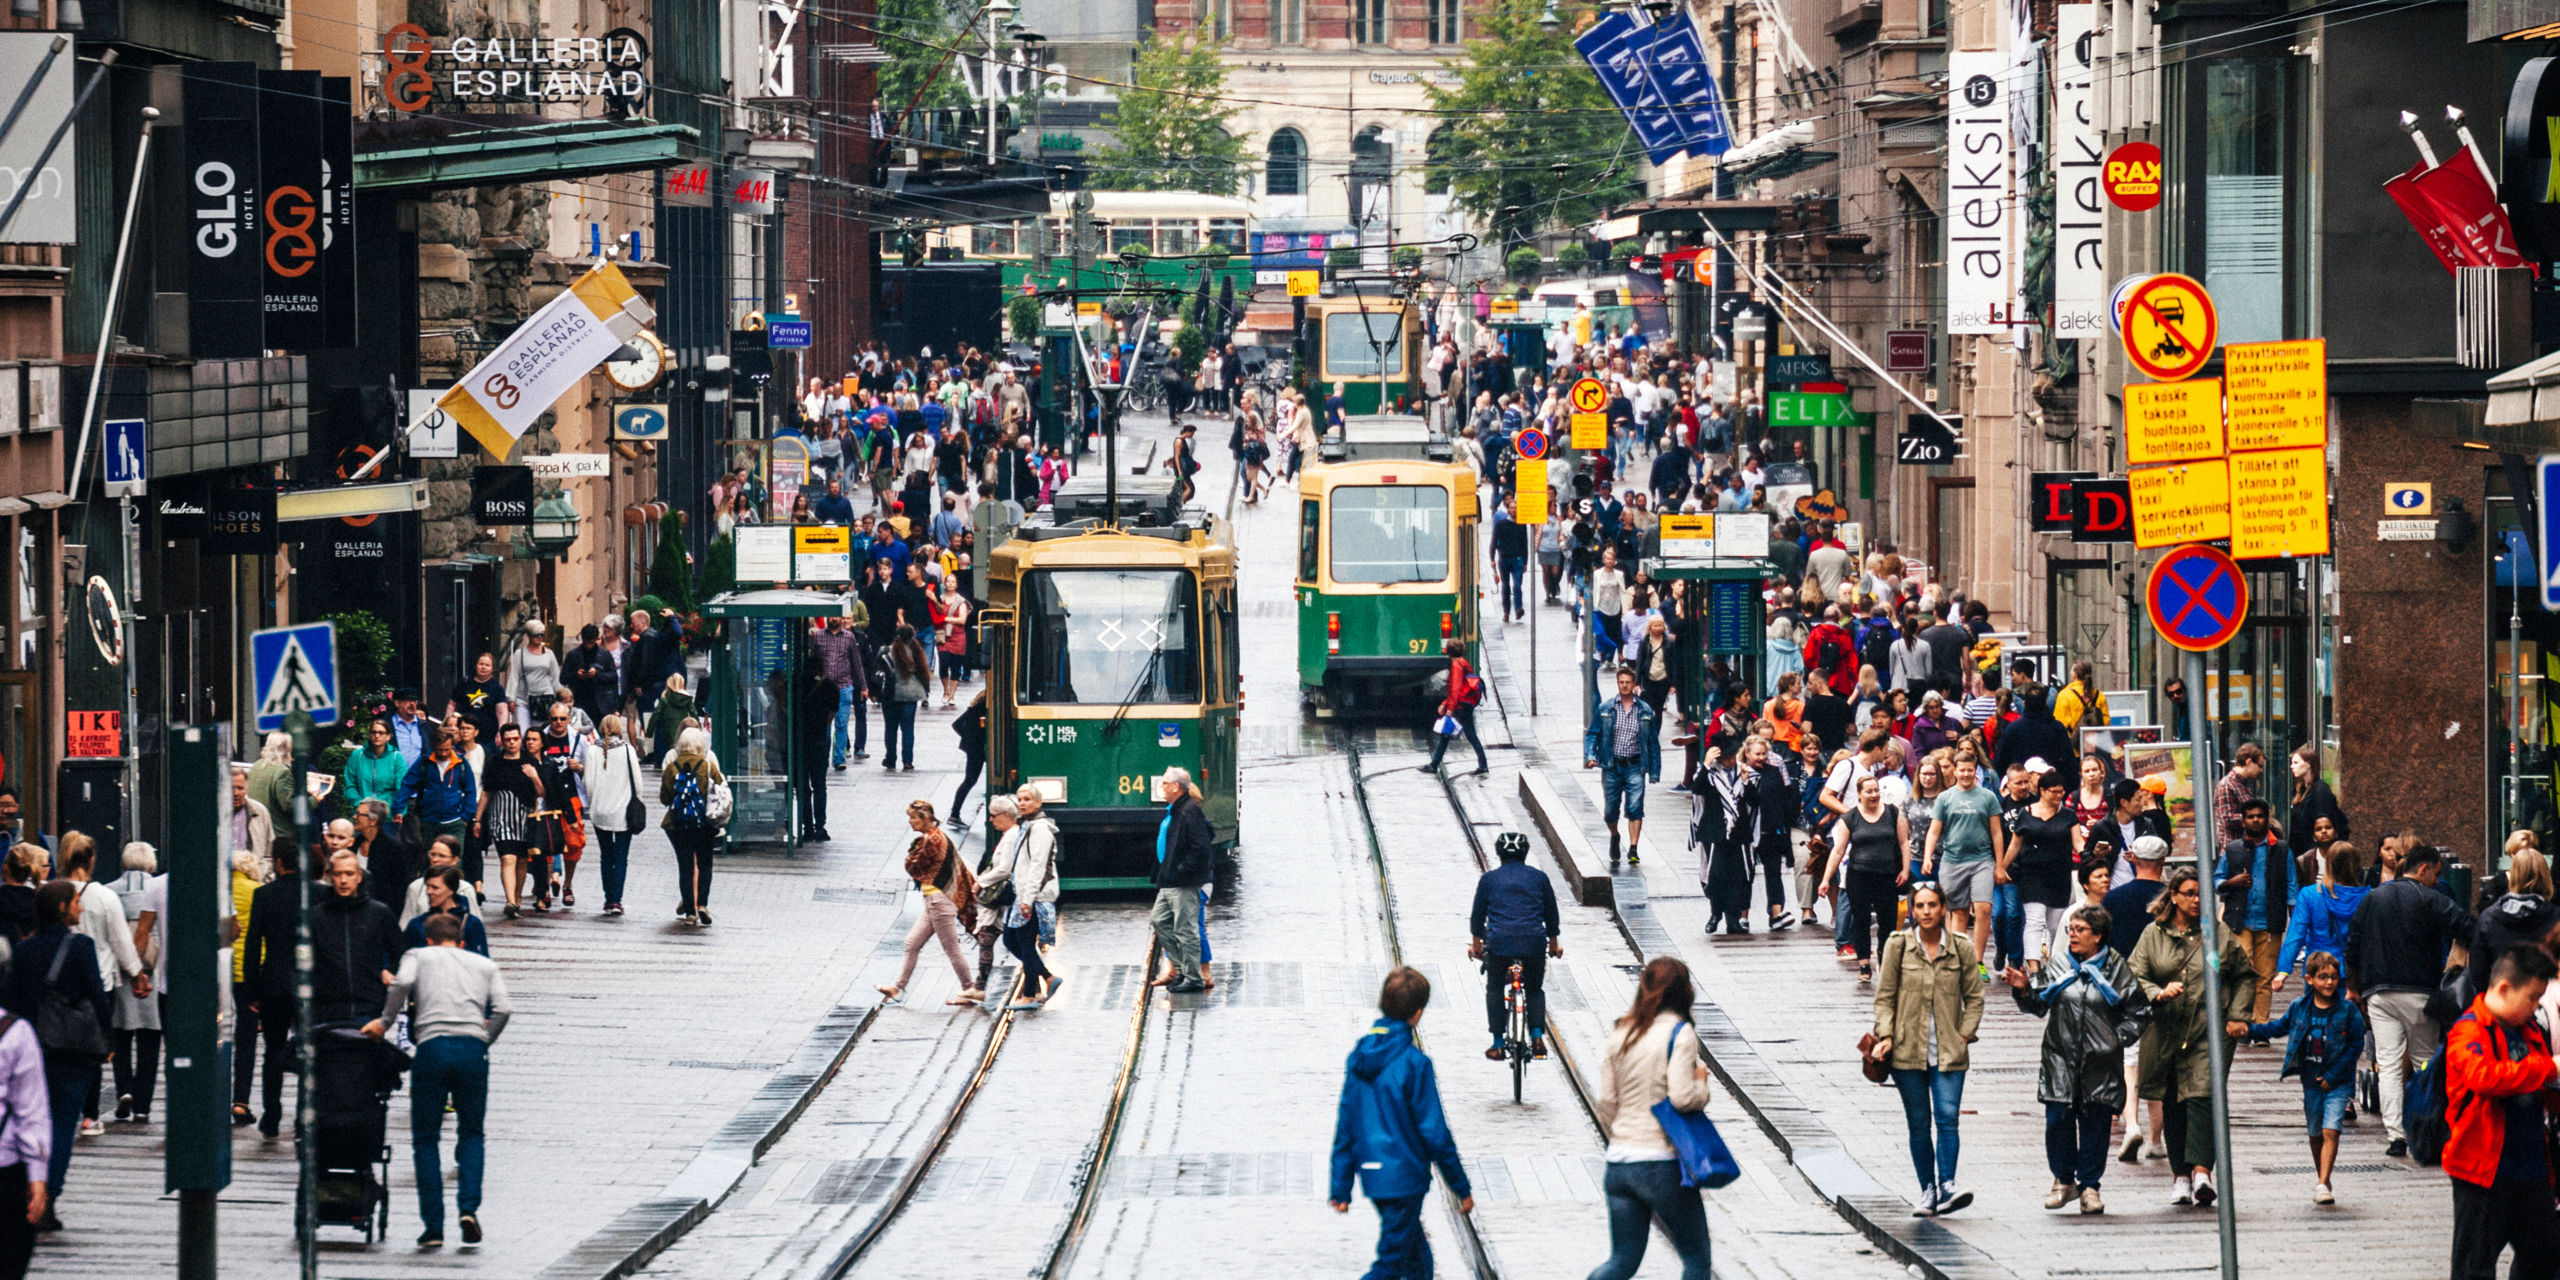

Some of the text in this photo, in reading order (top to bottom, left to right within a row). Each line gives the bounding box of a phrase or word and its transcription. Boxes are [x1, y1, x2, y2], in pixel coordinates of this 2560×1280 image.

[452, 37, 642, 63] GALLERIA
[950, 48, 1066, 100] Aktia
[453, 70, 644, 96] ESPLANAD
[1607, 47, 1669, 131] EVLI
[1657, 45, 1712, 124] EVLI
[1970, 82, 1990, 100] 13
[1040, 132, 1084, 150] Aktia
[2108, 160, 2161, 183] RAX
[667, 168, 708, 196] H&M
[733, 179, 770, 204] H&M
[1951, 118, 2003, 279] aleksi
[195, 161, 238, 258] GLO
[244, 188, 254, 230] HOTEL
[340, 182, 350, 225] HOTEL
[1288, 277, 1319, 295] 10 km/h
[264, 295, 319, 304] GALLERIA
[264, 304, 319, 312] ESPLANAD
[772, 325, 808, 336] Fenno
[508, 311, 579, 371] GALLERIA
[514, 318, 587, 380] ESPLANAD
[524, 328, 595, 388] FASHION DISTRICT
[1891, 347, 1924, 356] CATELLA
[2229, 378, 2267, 389] sallittu
[1929, 390, 1935, 399] B
[2138, 389, 2188, 405] Ei koske
[2307, 389, 2317, 400] ja
[2234, 404, 2286, 418] purkaville
[2235, 418, 2298, 432] ajoneuvoille
[1900, 437, 1941, 460] Zio
[562, 461, 571, 473] K
[593, 459, 602, 472] K
[2238, 457, 2299, 472] Tillåtet att
[2132, 475, 2185, 491] Gäller ej
[2238, 475, 2296, 490] stanna på
[1579, 499, 1593, 514] S
[2237, 490, 2313, 507] gångbanan för
[485, 501, 526, 513] BOSS
[2288, 505, 2307, 517] och
[2242, 522, 2286, 536] lossning
[2290, 519, 2297, 532] 5
[2310, 518, 2319, 531] 11
[334, 542, 384, 550] GALLERIA
[334, 550, 384, 558] ESPLANAD
[1408, 639, 1429, 654] 97
[1056, 726, 1078, 735] HSL
[1056, 734, 1078, 743] HRT
[1118, 775, 1146, 795] 84
